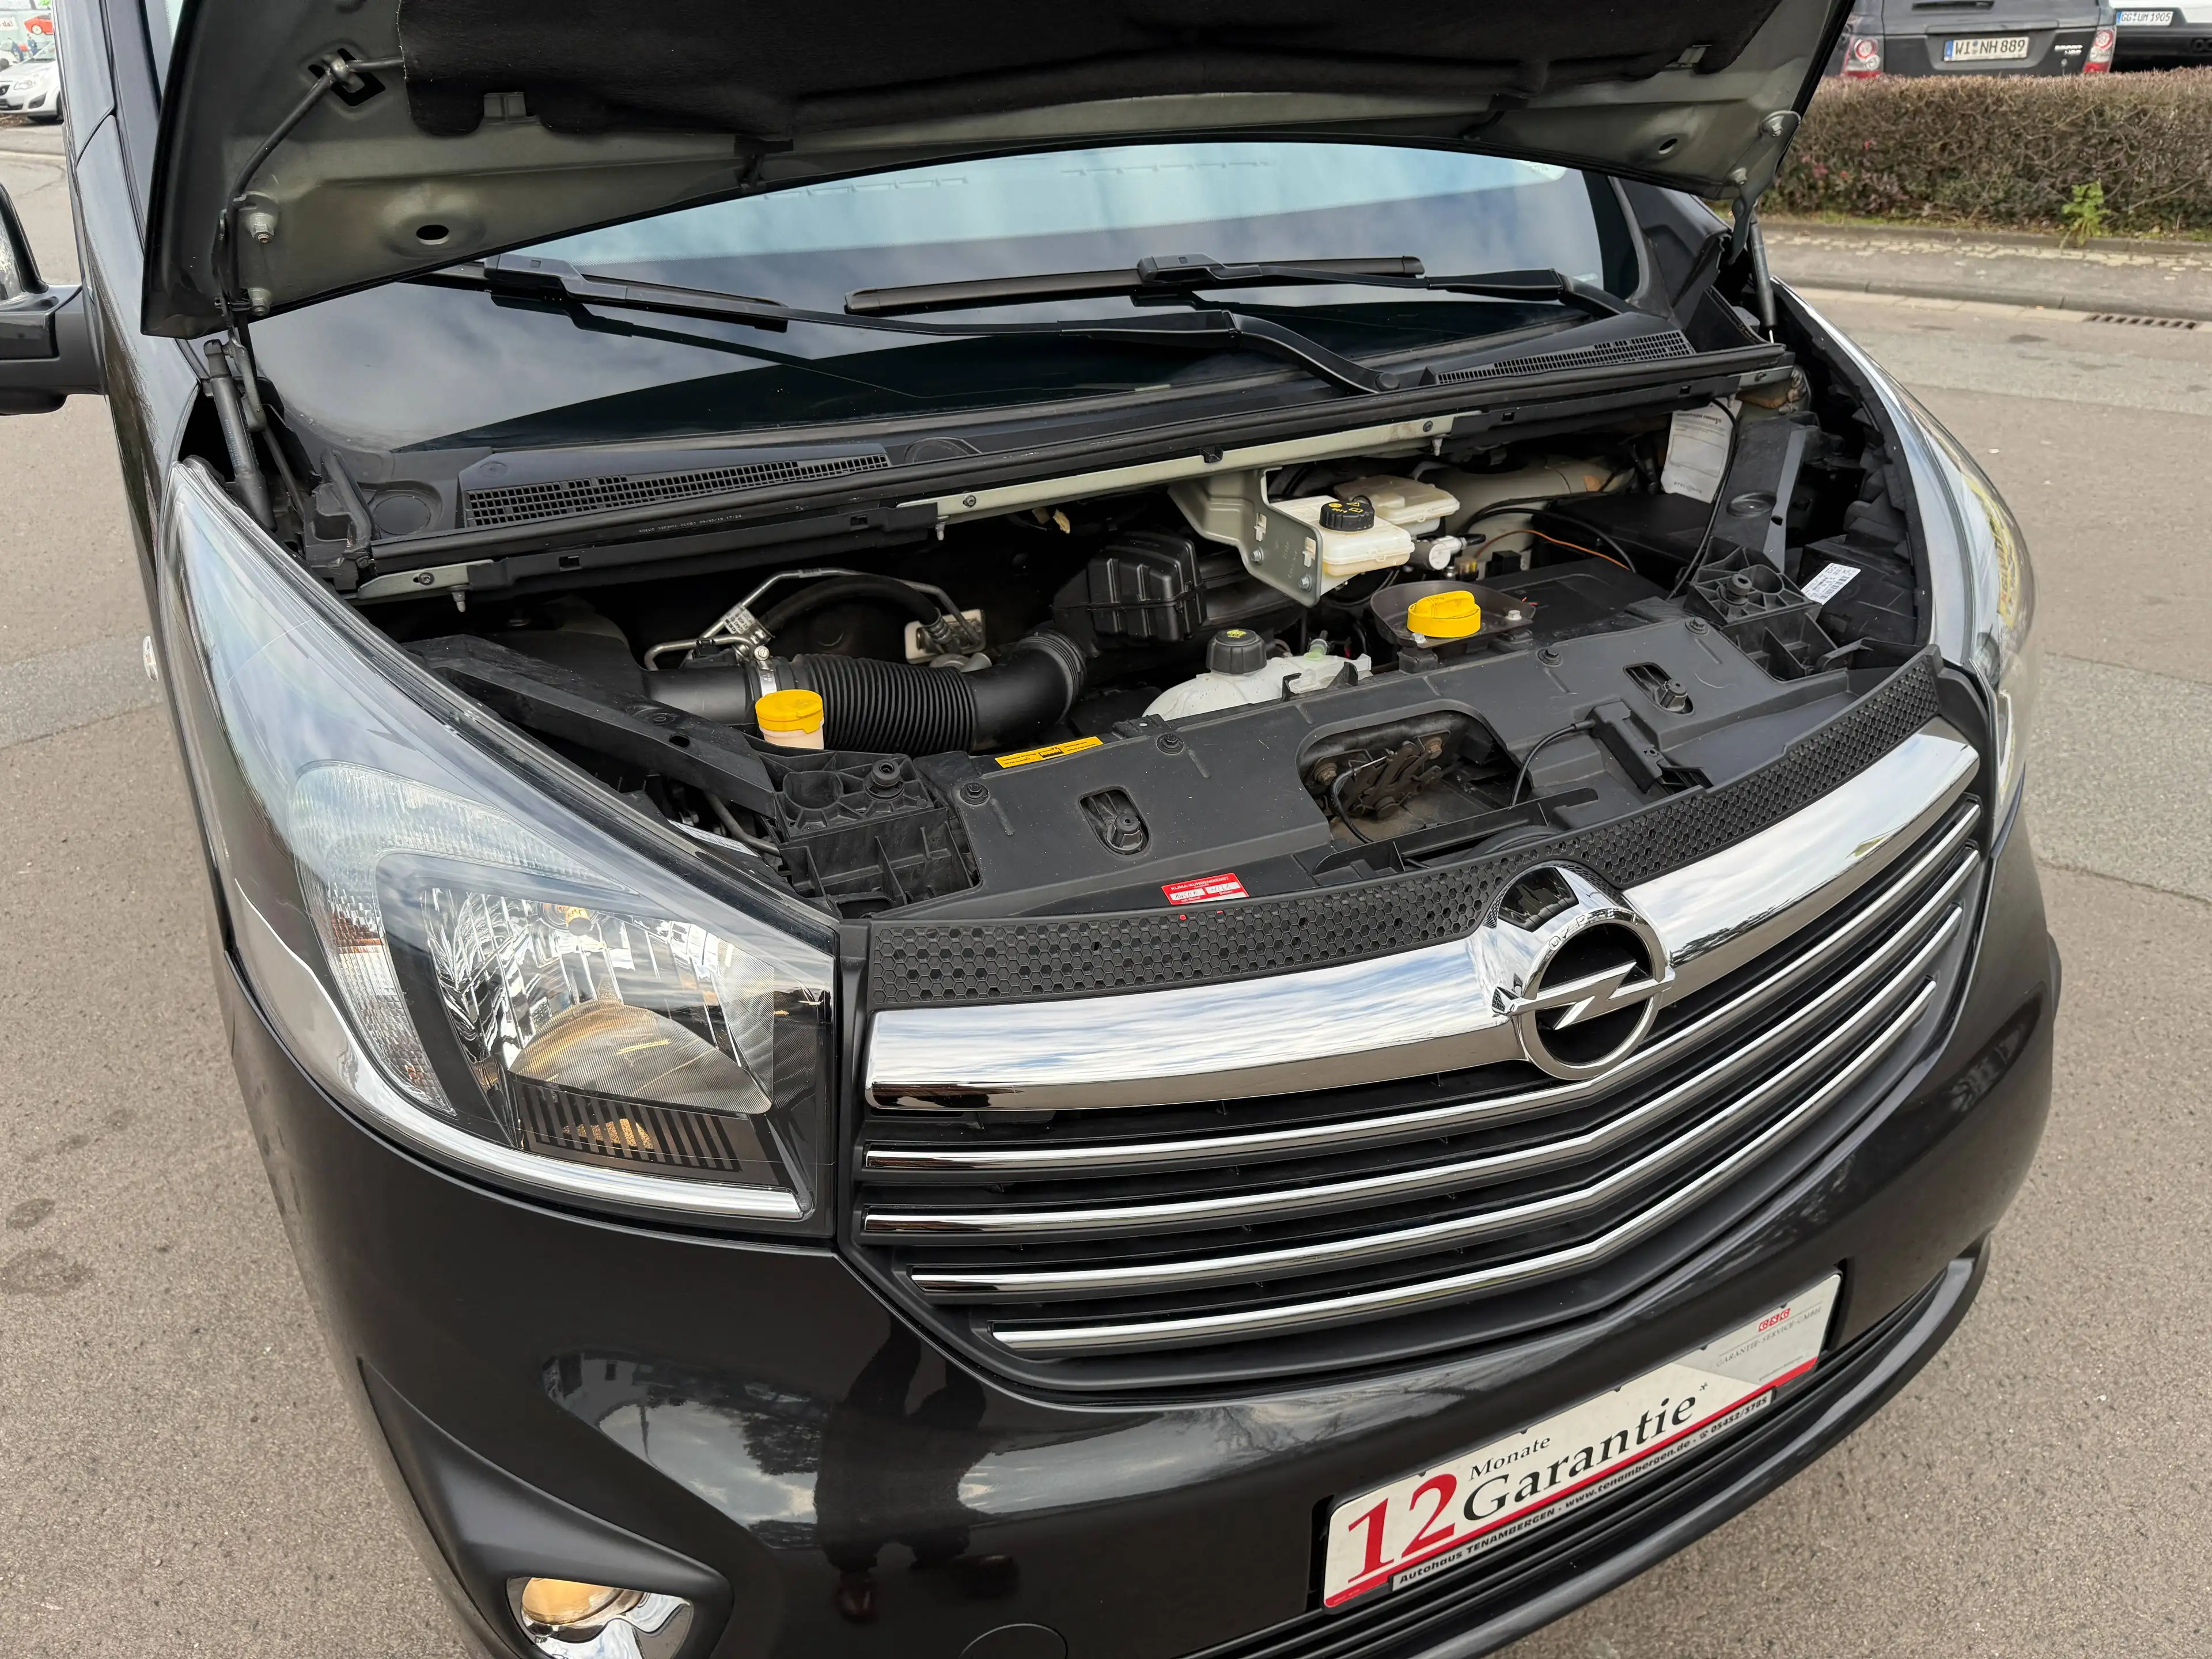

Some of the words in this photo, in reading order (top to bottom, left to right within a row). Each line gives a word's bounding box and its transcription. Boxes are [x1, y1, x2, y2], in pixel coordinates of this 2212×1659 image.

[2121, 12, 2133, 21] GG
[2150, 12, 2171, 21] 1905
[1955, 41, 1970, 55] WI
[1980, 39, 1998, 53] NH
[2000, 39, 2025, 52] 889
[1468, 1438, 1551, 1481] Monate
[1348, 1474, 1457, 1584] 12
[1463, 1396, 1696, 1521] Garantie
[1399, 1551, 1463, 1584] Autohaus
[1465, 1508, 1555, 1554] TENAMBERGEN
[1565, 1440, 1691, 1508] www.tenambergen.de
